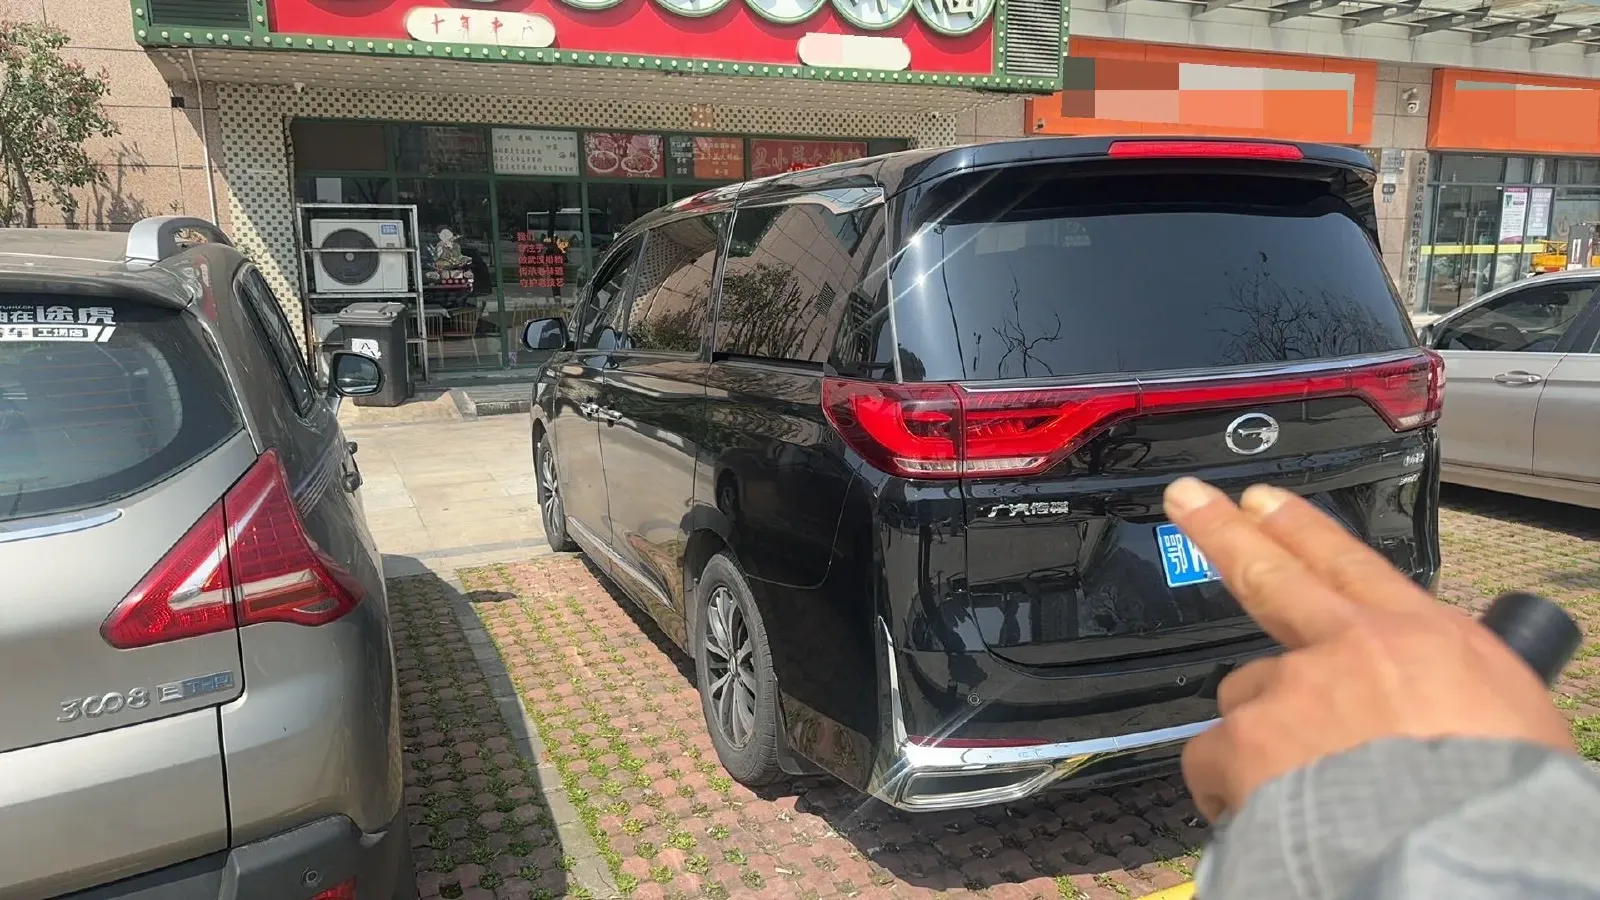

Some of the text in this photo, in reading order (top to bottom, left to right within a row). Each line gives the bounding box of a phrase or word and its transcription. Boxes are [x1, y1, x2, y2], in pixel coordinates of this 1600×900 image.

[987, 501, 1069, 517] 广汽传祺
[56, 686, 151, 722] 3008
